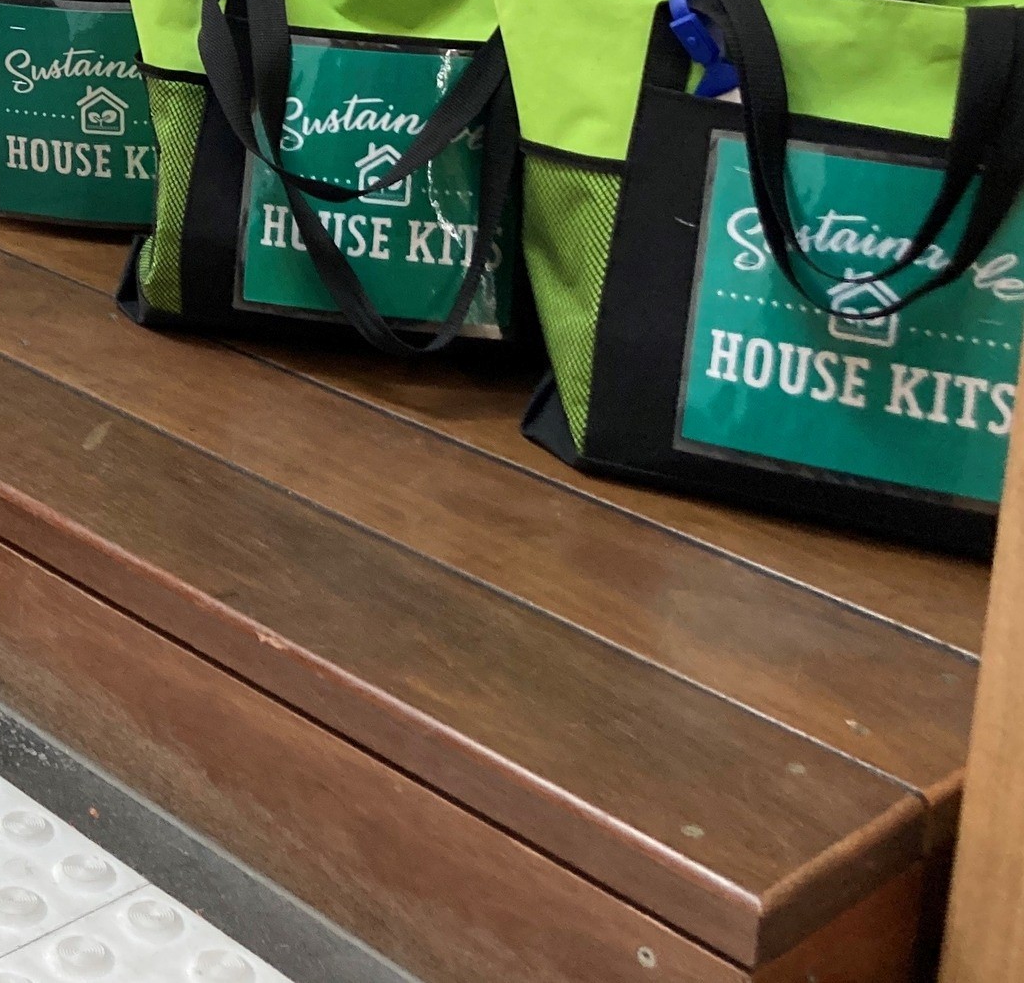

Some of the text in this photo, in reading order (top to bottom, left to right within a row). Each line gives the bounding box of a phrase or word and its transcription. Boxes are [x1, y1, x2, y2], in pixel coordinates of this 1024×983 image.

[279, 94, 484, 152] Sustain
[6, 135, 157, 180] HOUSE K
[706, 329, 1017, 436] HOUSE KITS
